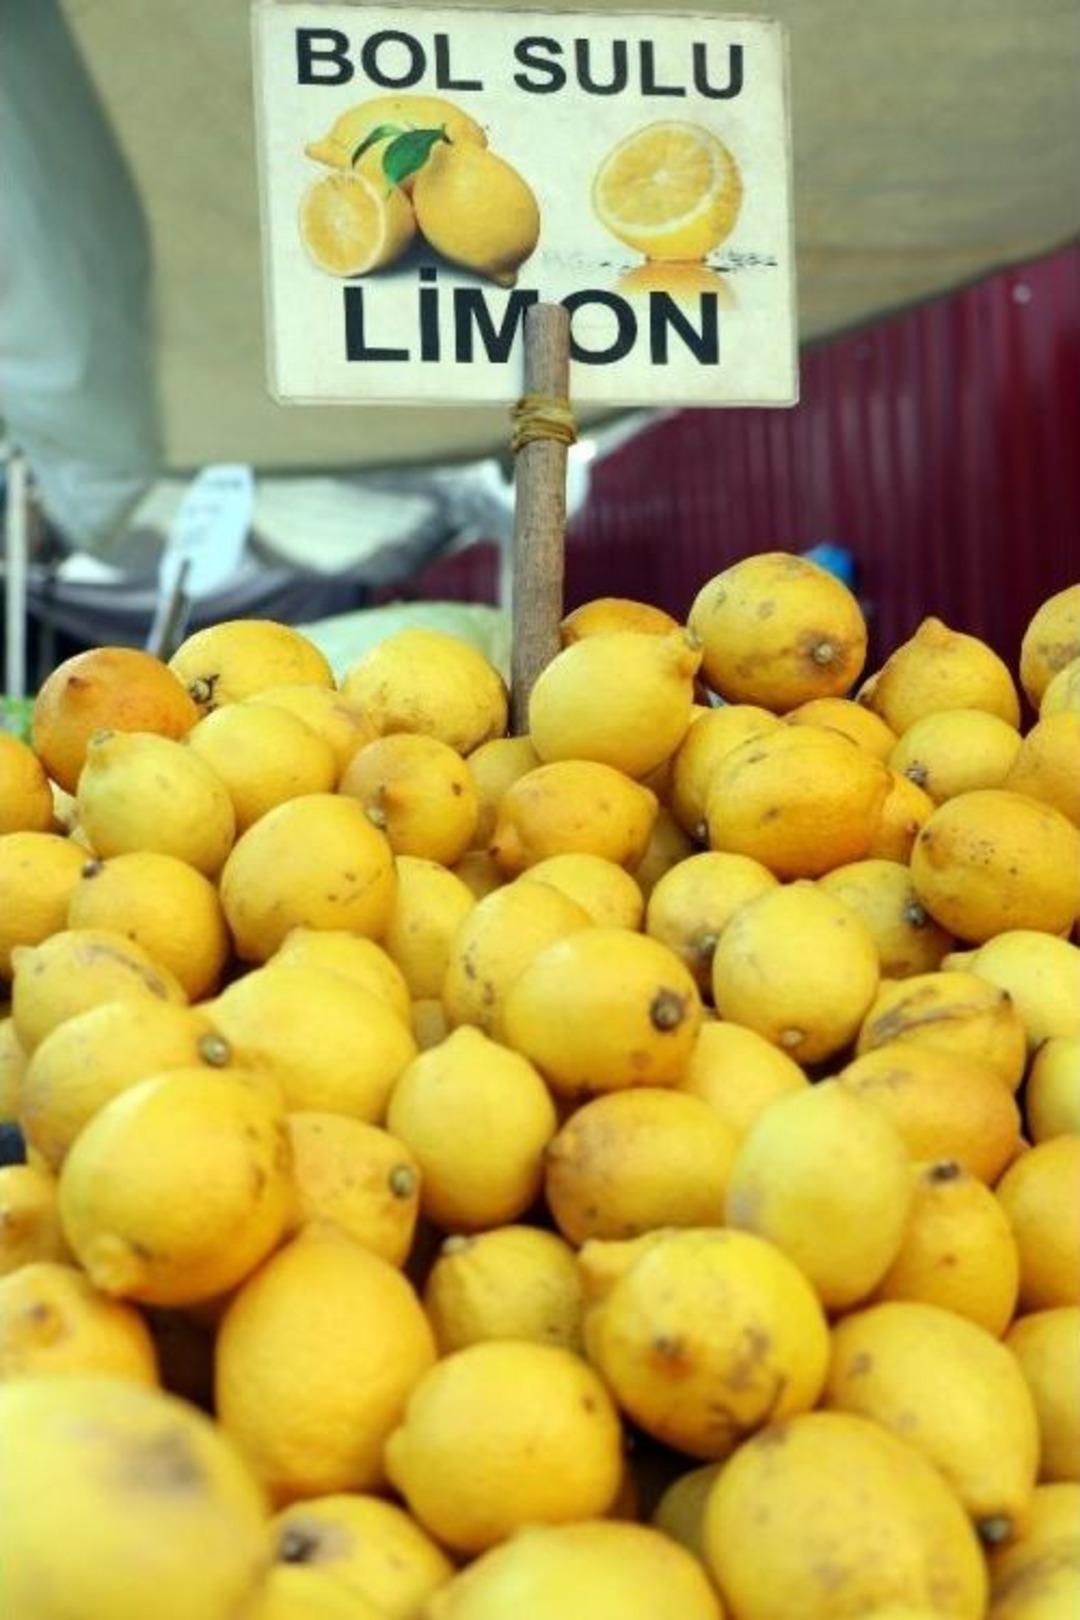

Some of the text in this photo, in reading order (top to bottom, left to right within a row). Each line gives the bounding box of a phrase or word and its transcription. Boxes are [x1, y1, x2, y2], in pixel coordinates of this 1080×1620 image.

[295, 27, 744, 99] BOL SULU
[343, 266, 719, 365] LİMON
